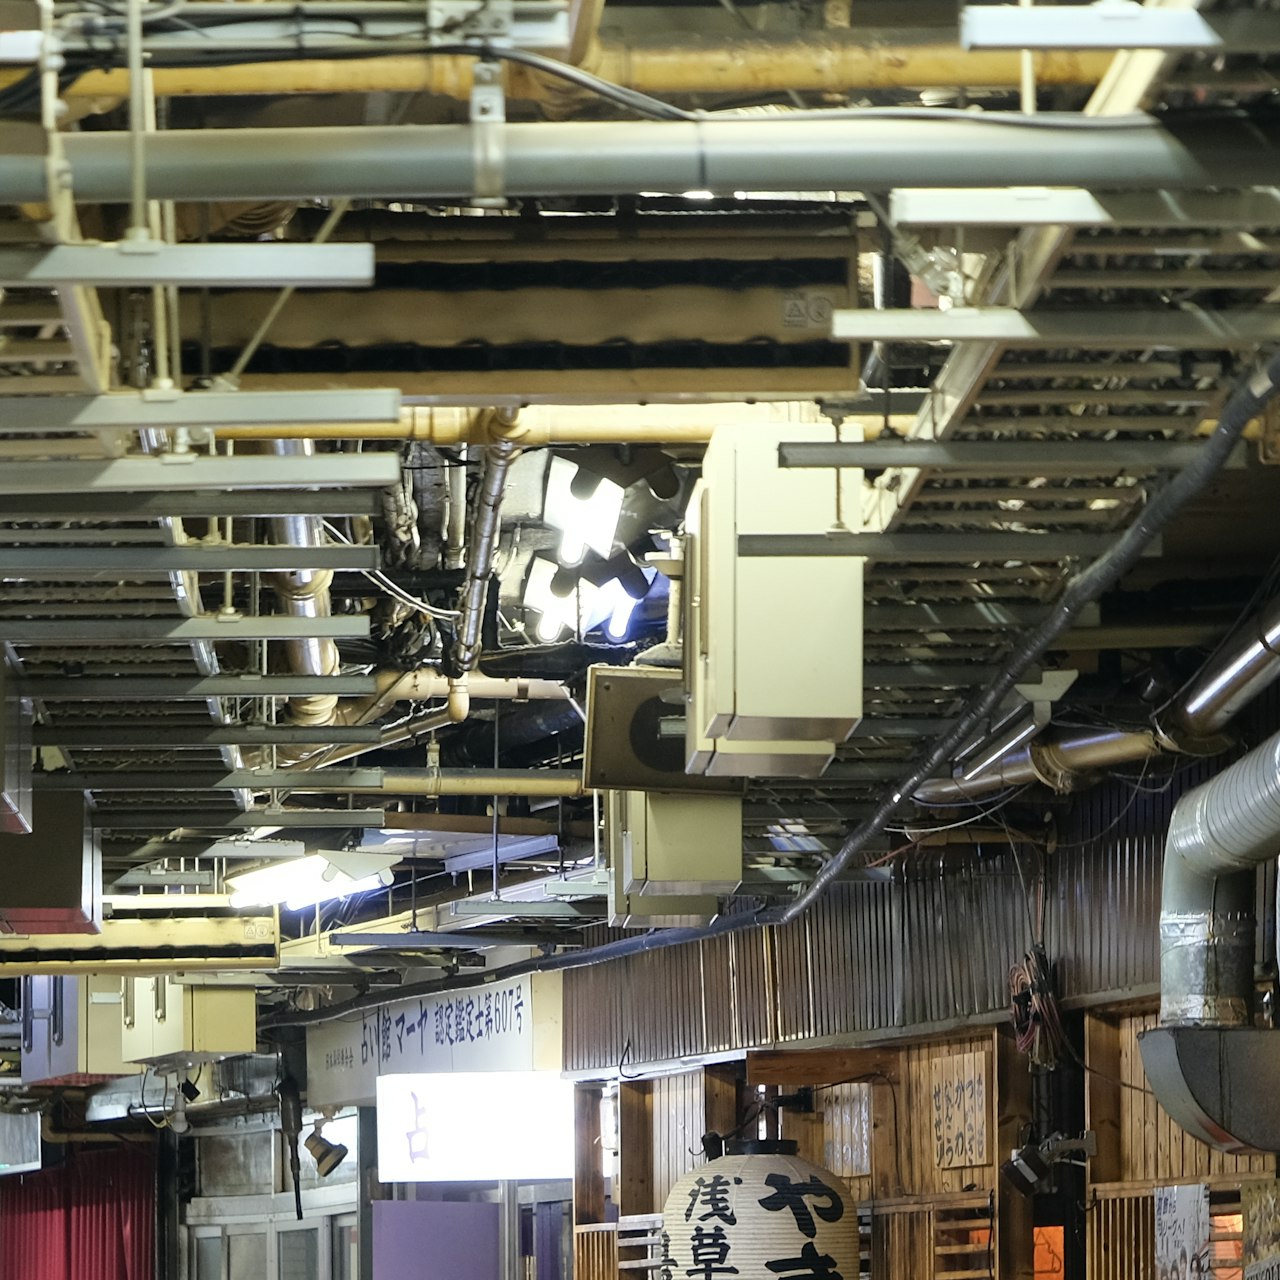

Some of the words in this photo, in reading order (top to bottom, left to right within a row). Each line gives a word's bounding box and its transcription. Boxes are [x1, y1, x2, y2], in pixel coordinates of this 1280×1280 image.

[395, 1000, 428, 1056] マーヤ
[955, 1079, 964, 1157] かわ
